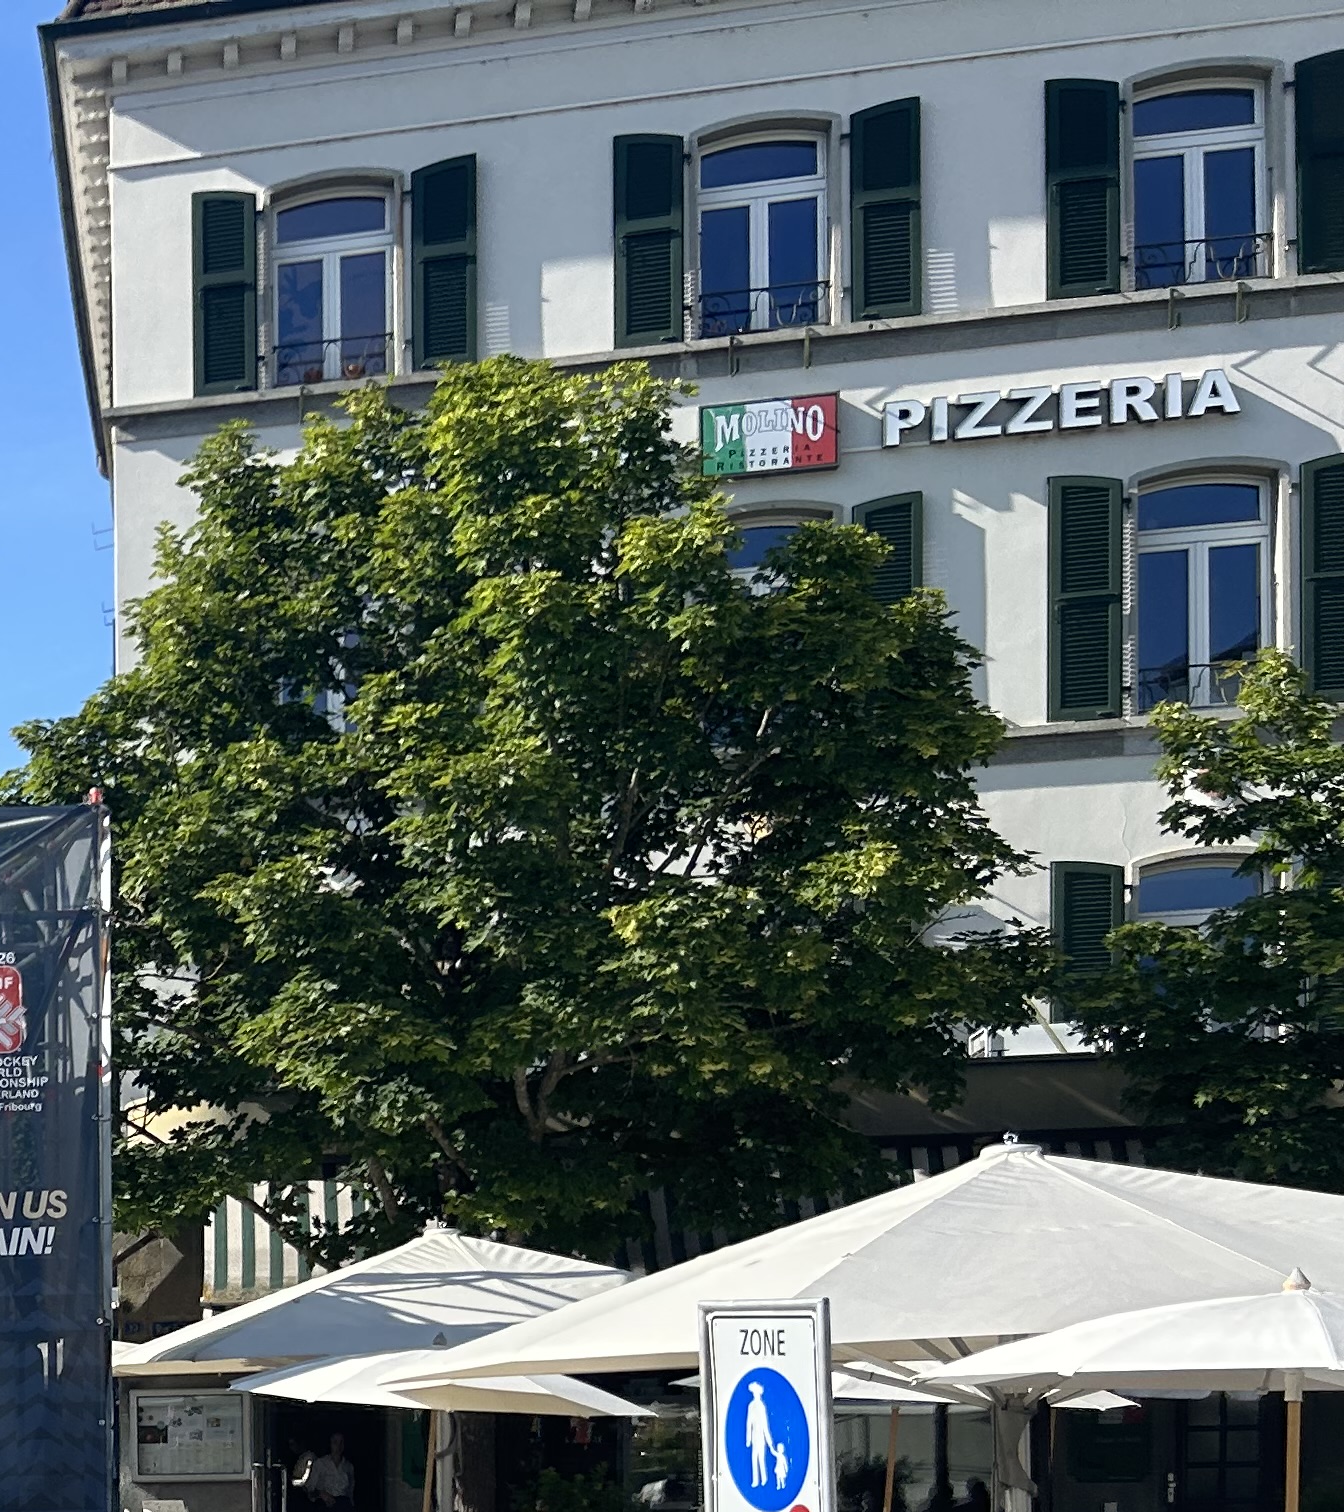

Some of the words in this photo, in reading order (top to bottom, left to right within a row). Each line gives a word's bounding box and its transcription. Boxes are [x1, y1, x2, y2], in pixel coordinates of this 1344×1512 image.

[883, 368, 1242, 448] PIZZERIA
[714, 404, 825, 453] MOLINO
[716, 454, 823, 473] RISTORANTE
[728, 444, 811, 459] PIZZERIA
[22, 1189, 68, 1220] US
[739, 1328, 787, 1357] ZONE
